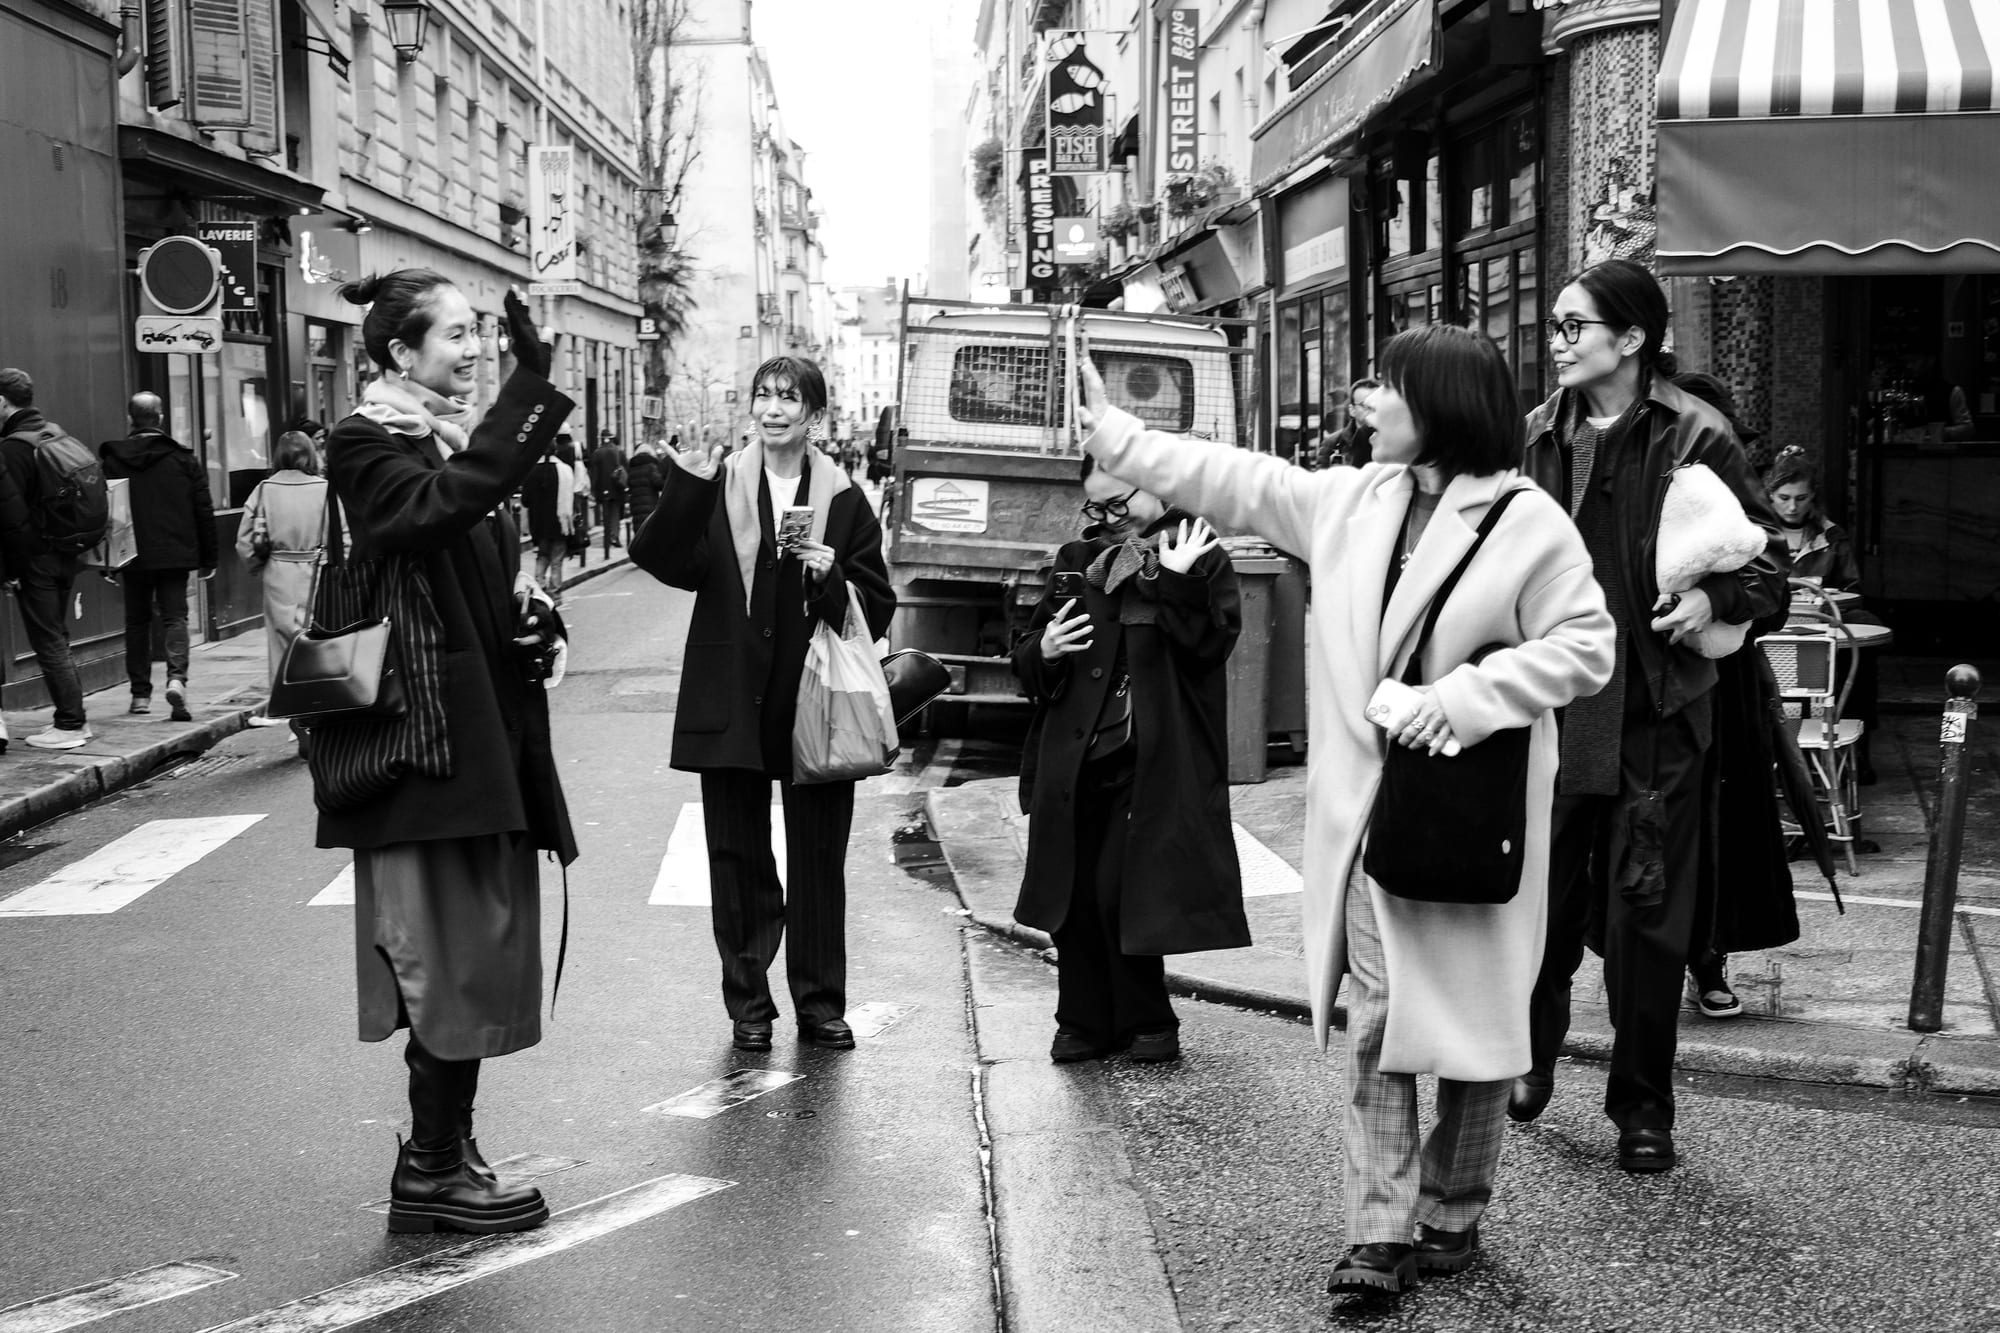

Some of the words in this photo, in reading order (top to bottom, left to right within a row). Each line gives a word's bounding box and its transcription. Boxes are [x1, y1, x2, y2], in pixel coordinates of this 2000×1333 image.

[1171, 10, 1185, 56] BANG
[1182, 26, 1196, 60] KOK
[1170, 65, 1195, 171] STREET
[1055, 136, 1098, 154] FISH
[199, 229, 254, 241] LAVERIE
[1029, 160, 1055, 278] PRESSING
[640, 318, 656, 334] B
